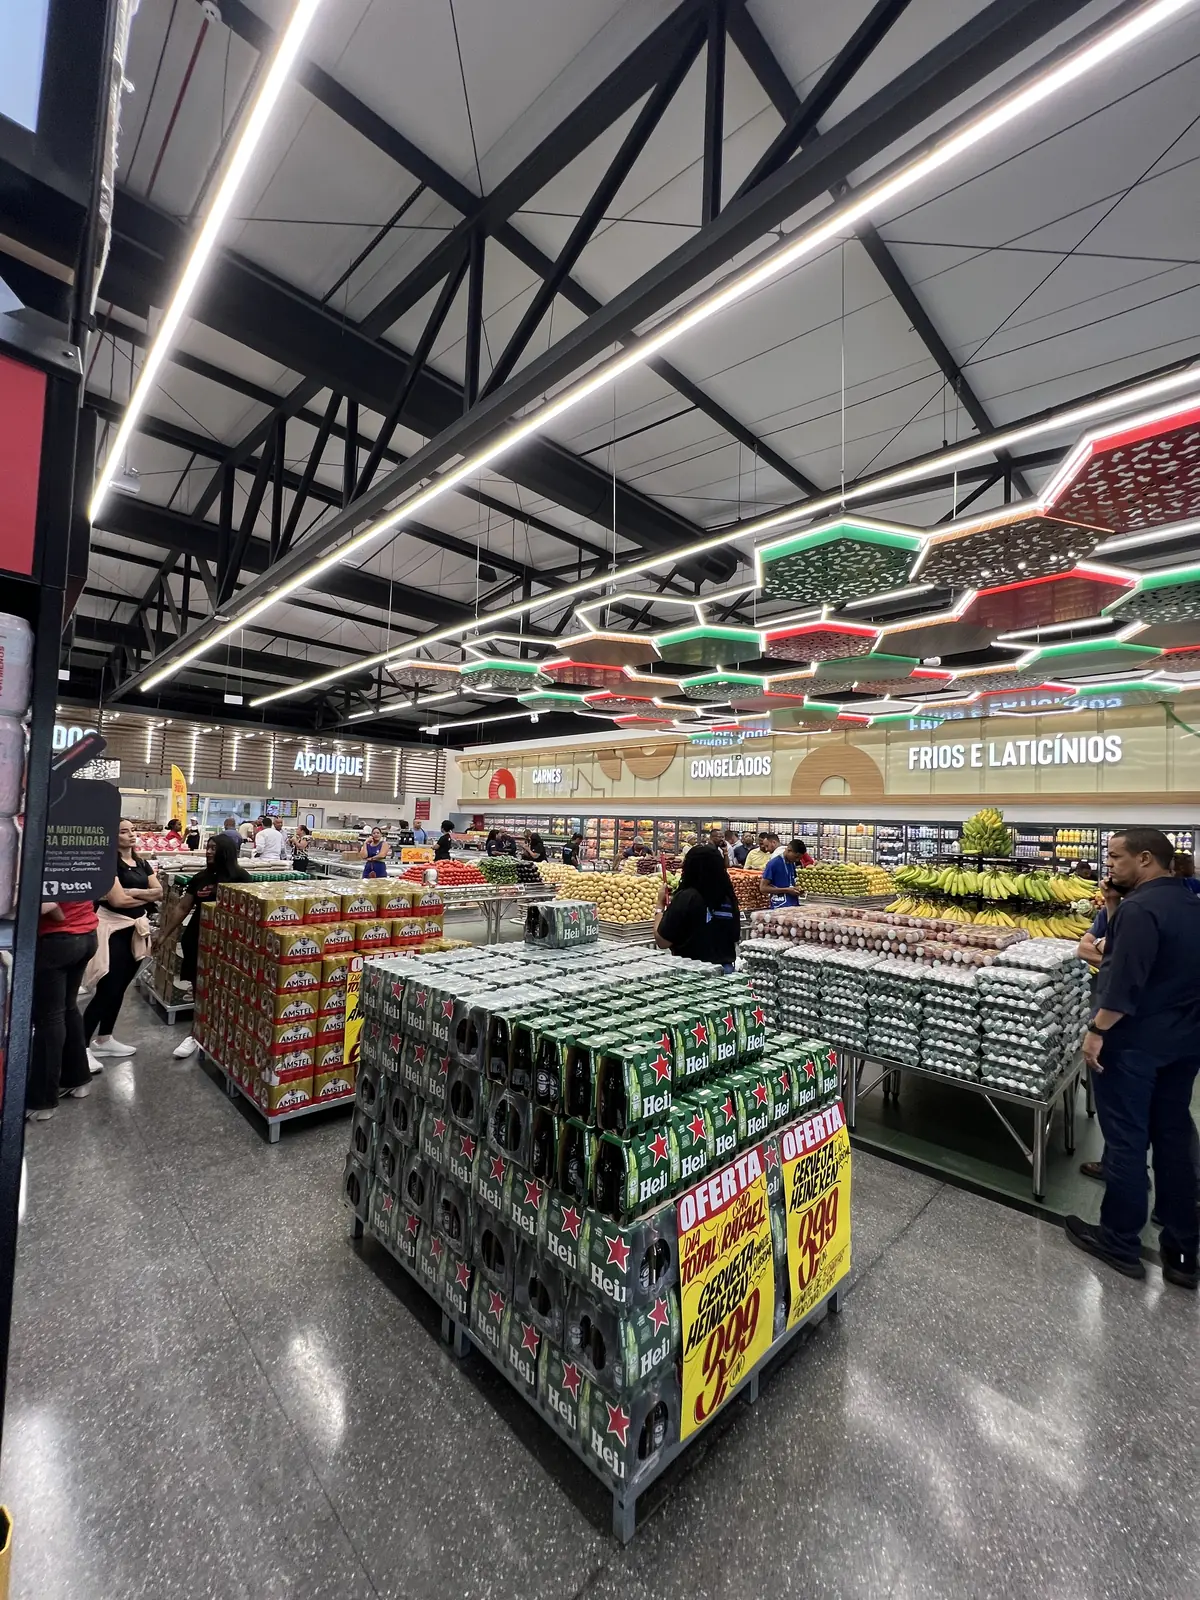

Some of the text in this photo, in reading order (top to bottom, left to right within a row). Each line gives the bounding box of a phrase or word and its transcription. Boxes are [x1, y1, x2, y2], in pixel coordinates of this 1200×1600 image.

[53, 725, 98, 750] DO
[908, 733, 1122, 770] FRIOS E LATICÍNIOS
[294, 751, 364, 777] AÇOUGUE
[691, 756, 772, 778] CONGELADOS
[532, 768, 562, 784] CARNES
[56, 825, 82, 834] MUITO
[84, 826, 104, 834] MAIS
[62, 836, 110, 846] BRINDAR!
[60, 881, 92, 890] total
[325, 936, 351, 944] AMSTEL
[289, 947, 319, 956] AMSTEL
[286, 978, 315, 988] AMSTEL
[326, 1000, 346, 1008] AMST
[283, 1008, 312, 1018] AMSTEL
[325, 1022, 345, 1032] AMST
[281, 1032, 310, 1042] AMSTEL
[282, 1058, 310, 1069] AMSTEL
[322, 1084, 348, 1096] AMSTEL
[279, 1094, 307, 1108] AMSTEL
[782, 1104, 844, 1161] OFERTA
[793, 1140, 834, 1187] CERVEJA
[680, 1150, 762, 1232] OFERTA
[789, 1161, 839, 1214] HEINEKEN
[721, 1196, 766, 1251] RAFAEL
[681, 1235, 718, 1287] TOTAL
[698, 1238, 754, 1315] CERVEJA
[684, 1271, 749, 1356] HEINEKEN
